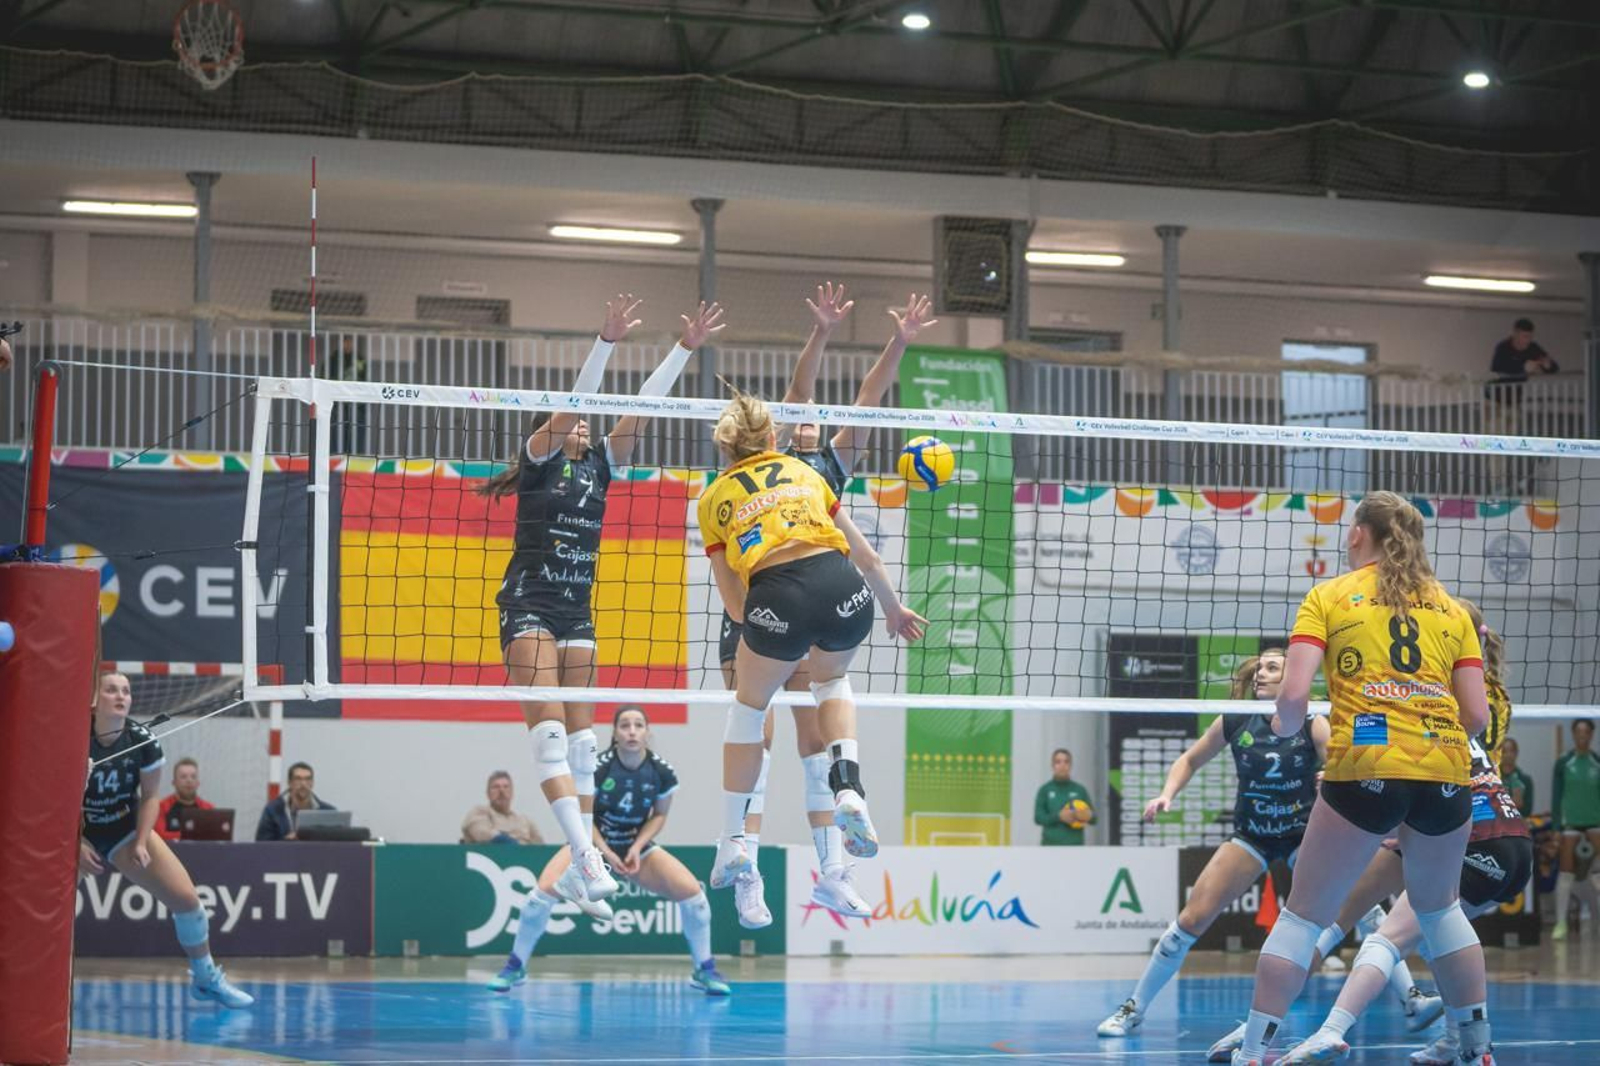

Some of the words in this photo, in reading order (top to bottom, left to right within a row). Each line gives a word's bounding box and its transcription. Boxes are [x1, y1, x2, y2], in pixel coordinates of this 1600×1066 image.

[397, 389, 420, 399] CEV
[599, 400, 630, 408] Volleyball
[630, 400, 661, 410] Challenge
[662, 402, 675, 411] Cup
[848, 411, 877, 420] Volleyball
[877, 413, 907, 422] Challenge
[908, 414, 921, 422] Cup
[729, 462, 792, 496] 12
[578, 479, 593, 508] 7
[140, 564, 289, 618] CEV
[1388, 615, 1422, 674] 8
[1264, 752, 1282, 778] 2
[94, 769, 120, 793] 14
[618, 791, 633, 812] 4
[799, 869, 1041, 930] Adalucía
[1074, 919, 1102, 930] Junta
[1105, 919, 1117, 930] de
[1119, 918, 1169, 930] Andalucía
